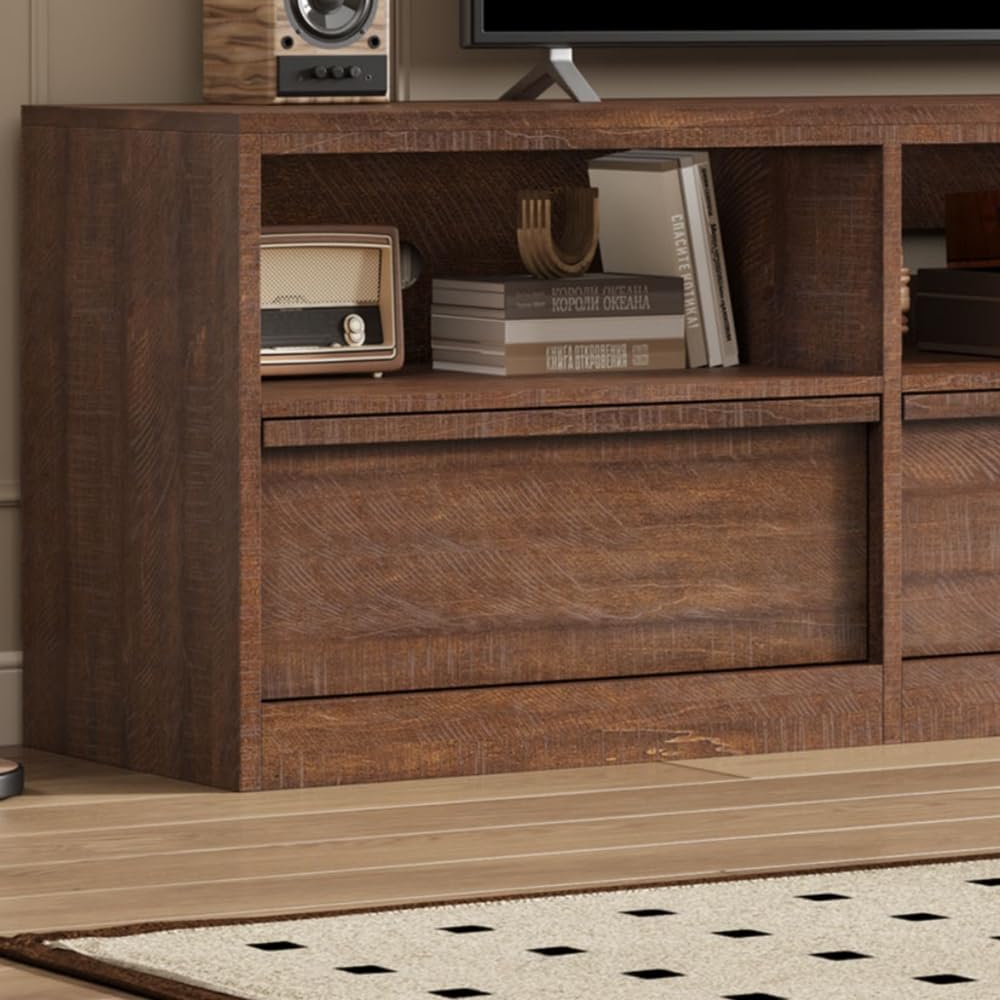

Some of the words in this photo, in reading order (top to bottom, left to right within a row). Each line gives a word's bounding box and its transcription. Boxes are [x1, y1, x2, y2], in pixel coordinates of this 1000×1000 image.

[671, 213, 690, 271] СПАСИТЕ
[552, 297, 599, 312] КОРОЛИ
[603, 295, 651, 311] ОКЕАНА
